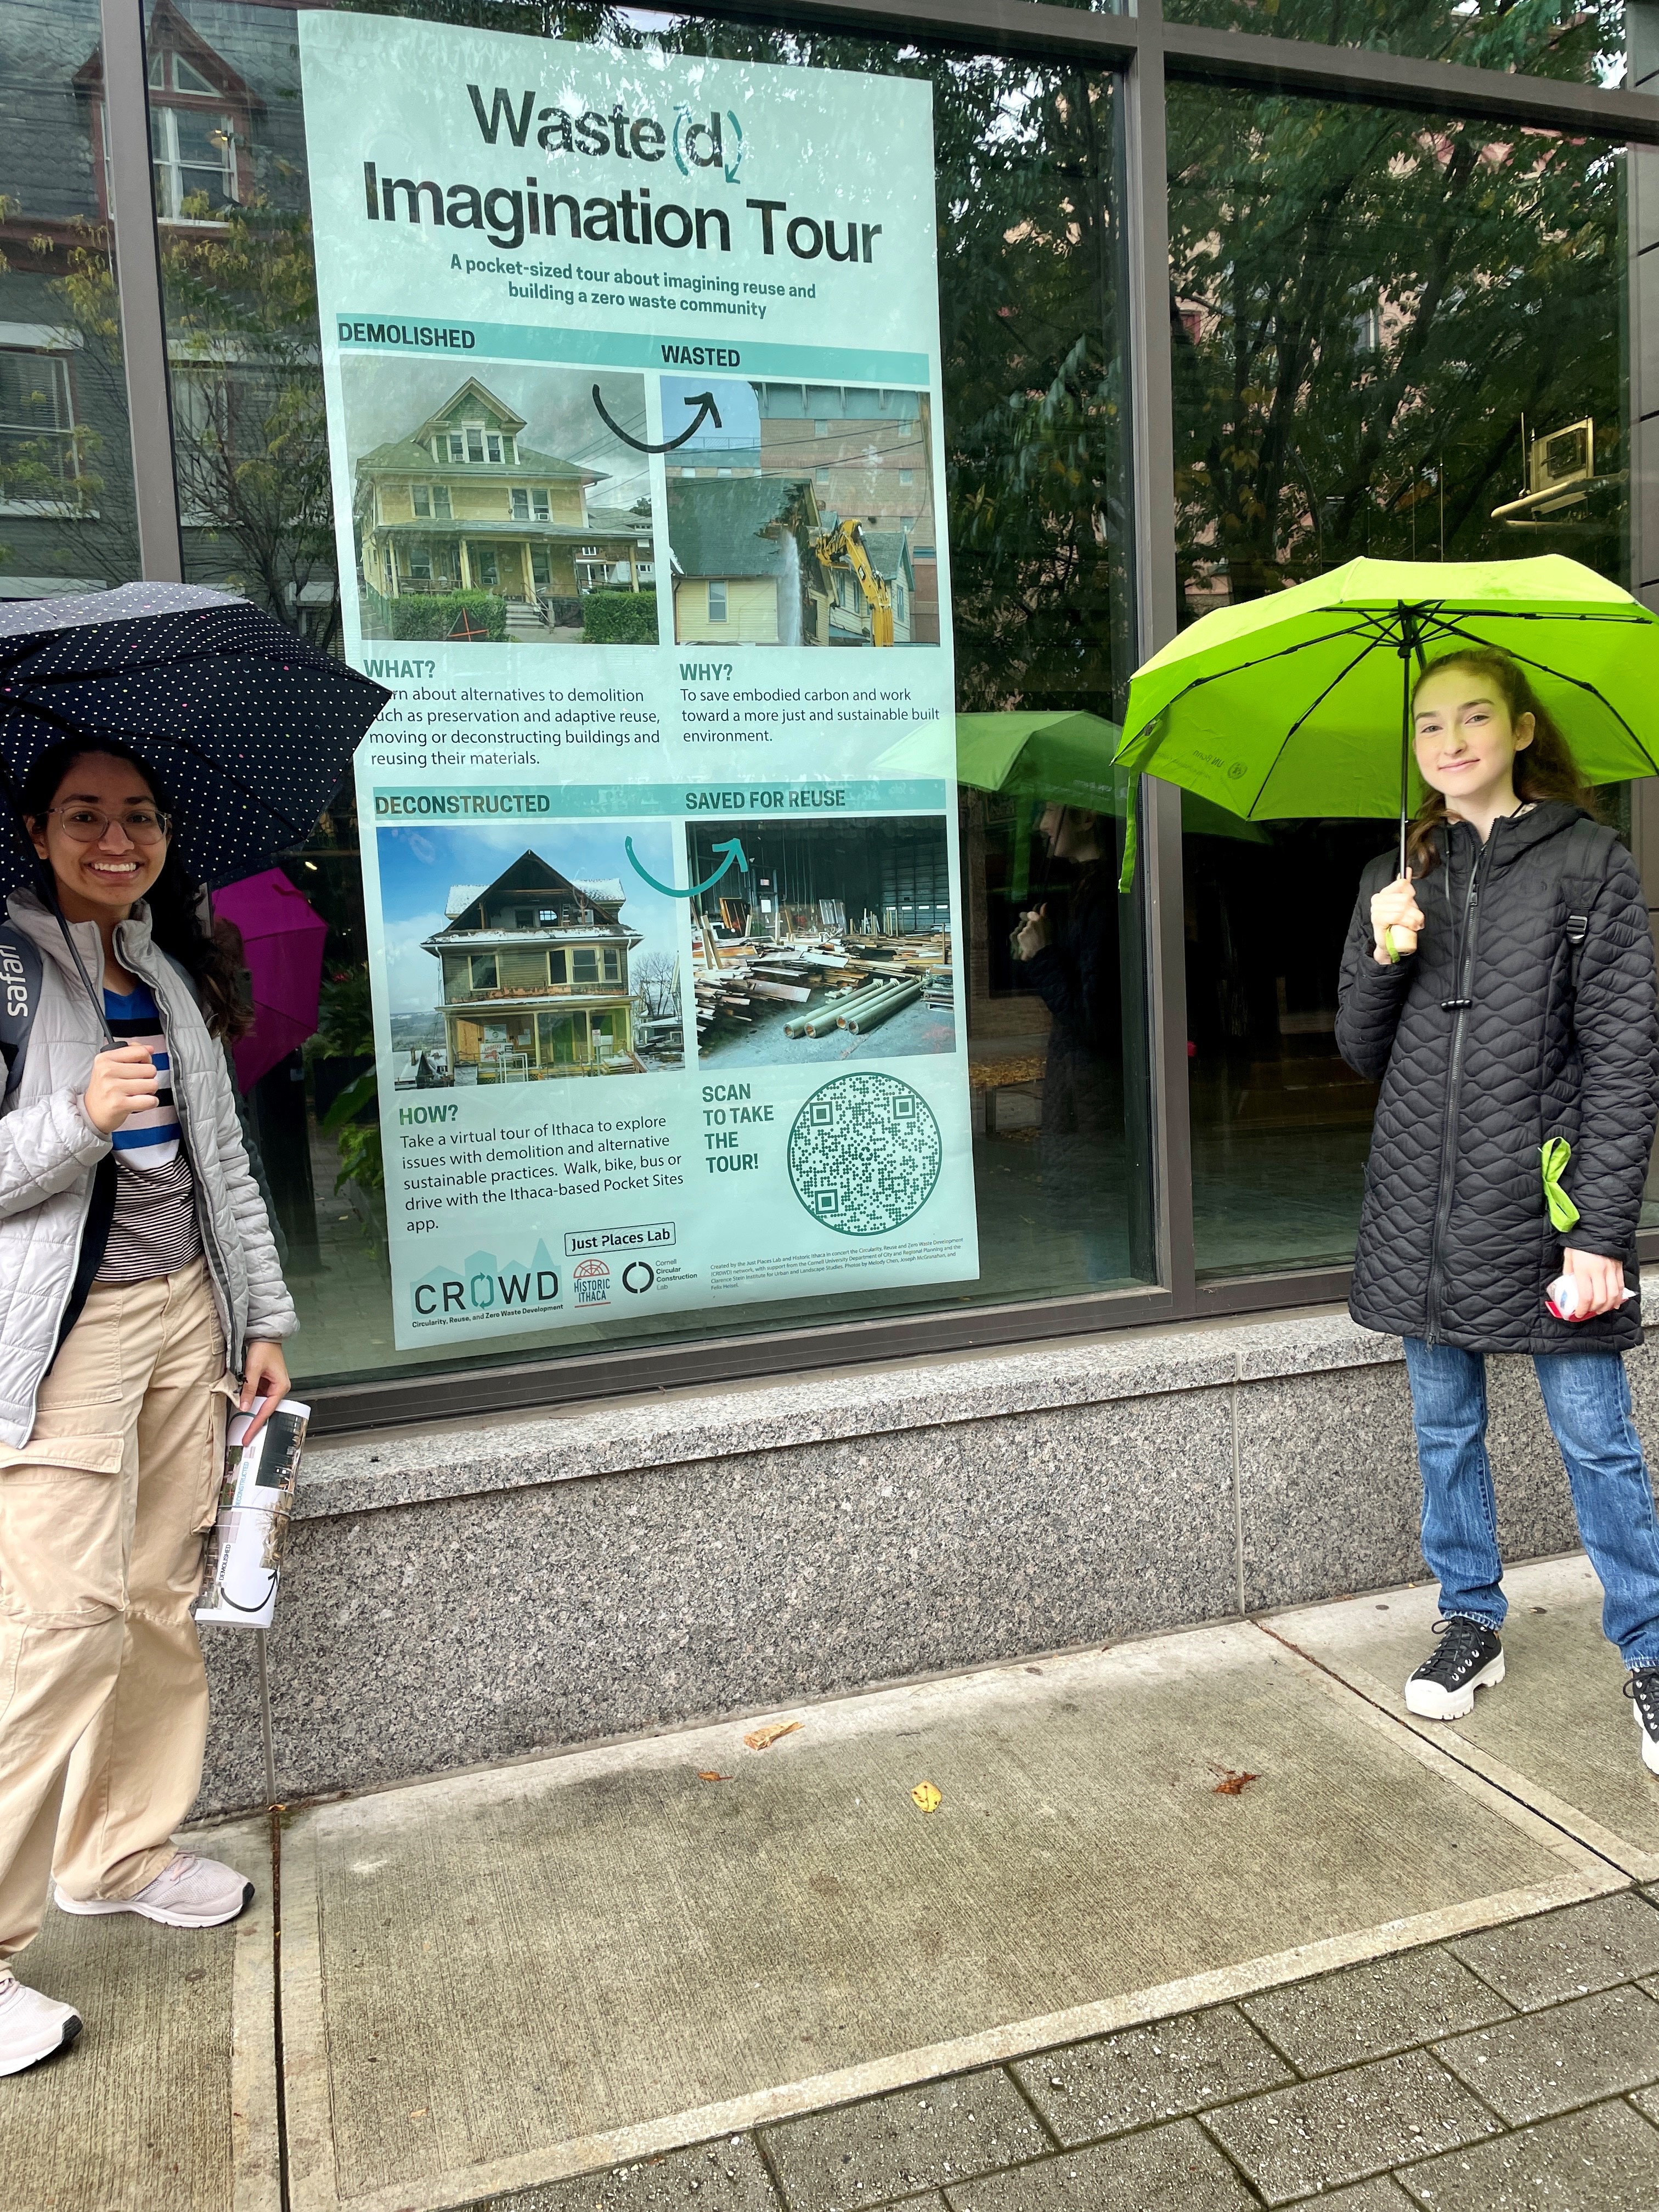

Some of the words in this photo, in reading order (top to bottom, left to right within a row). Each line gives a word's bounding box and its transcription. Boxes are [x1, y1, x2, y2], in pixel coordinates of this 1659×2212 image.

[364, 162, 731, 251] Imagination
[746, 199, 882, 263] Tour
[451, 254, 462, 269] A
[466, 257, 572, 279] pocket-sized
[577, 267, 610, 282] tour
[614, 269, 659, 286] about
[664, 272, 739, 296] imagining
[743, 283, 785, 296] reuse
[789, 284, 815, 298] and
[509, 281, 574, 305] building
[578, 289, 588, 305] a
[591, 293, 624, 305] zero
[629, 296, 676, 309] waste
[680, 300, 766, 319] community
[338, 323, 475, 348] DEMOLISHED
[661, 345, 740, 366] WASTED
[364, 660, 435, 678] WHAT?
[680, 664, 732, 680] WHY?
[413, 687, 456, 700] about
[461, 687, 545, 701] alternatives
[549, 690, 563, 701] to
[568, 688, 643, 701] demolition
[680, 689, 696, 701] To
[701, 692, 729, 701] save
[733, 689, 800, 701] embodied
[805, 689, 849, 701] carbon
[853, 689, 876, 701] and
[880, 689, 911, 700] work
[375, 710, 403, 723] uch
[408, 712, 422, 721] as
[428, 709, 519, 725] preservation
[524, 709, 550, 722] and
[555, 709, 616, 725] adaptive
[620, 713, 659, 724] reuse,
[682, 709, 729, 721] toward
[733, 713, 740, 721] a
[745, 712, 778, 721] more
[782, 709, 805, 724] just
[810, 708, 833, 720] and
[838, 708, 908, 720] sustainable
[912, 708, 939, 720] built
[370, 731, 426, 746] moving
[432, 734, 447, 743] or
[452, 730, 561, 746] deconstructing
[566, 730, 630, 746] buildings
[635, 730, 659, 743] and
[684, 730, 772, 742] environment.
[372, 752, 426, 768] reusing
[431, 751, 465, 764] their
[471, 751, 539, 764] materials.
[375, 793, 550, 815] DECONSTRUCTED
[685, 791, 745, 810] SAVED
[750, 791, 784, 808] FOR
[789, 789, 846, 808] REUSE
[703, 1084, 751, 1102] SCAN
[399, 1104, 458, 1126] HOW?
[703, 1109, 726, 1126] TO
[730, 1105, 774, 1124] TAKE
[400, 1135, 433, 1148] Take
[438, 1135, 446, 1146] a
[450, 1128, 495, 1144] virtual
[500, 1129, 530, 1139] tour
[534, 1124, 548, 1137] of
[552, 1122, 594, 1136] Ithaca
[597, 1121, 611, 1131] to
[616, 1116, 665, 1132] explore
[704, 1132, 738, 1149] THE
[403, 1157, 445, 1169] issues
[450, 1150, 481, 1164] with
[487, 1145, 563, 1161] demolition
[568, 1140, 593, 1154] and
[599, 1136, 669, 1152] alternative
[706, 1153, 758, 1173] TOUR!
[404, 1171, 486, 1189] sustainable
[492, 1166, 557, 1185] practices.
[564, 1160, 600, 1175] Walk,
[605, 1158, 636, 1171] bike,
[641, 1156, 664, 1167] bus
[668, 1156, 681, 1165] or
[405, 1197, 442, 1210] drive
[447, 1192, 478, 1206] with
[482, 1190, 506, 1203] the
[511, 1180, 599, 1200] Ithaca-based
[605, 1177, 649, 1191] Pocket
[653, 1174, 683, 1186] Sites
[407, 1220, 438, 1233] app.
[572, 1237, 598, 1251] Just
[602, 1234, 644, 1247] Places
[647, 1228, 670, 1242] Lab
[825, 1256, 848, 1264] University
[574, 1278, 610, 1293] HISTORIC
[657, 1273, 697, 1282] Construction
[415, 1271, 558, 1314] CROWD
[579, 1290, 606, 1302] ITHACA
[412, 1319, 448, 1328] Circularity,
[522, 1304, 563, 1314] Development
[235, 1461, 249, 1507] DECONSTRUCTED
[219, 1544, 232, 1581] DEMOLISHED
